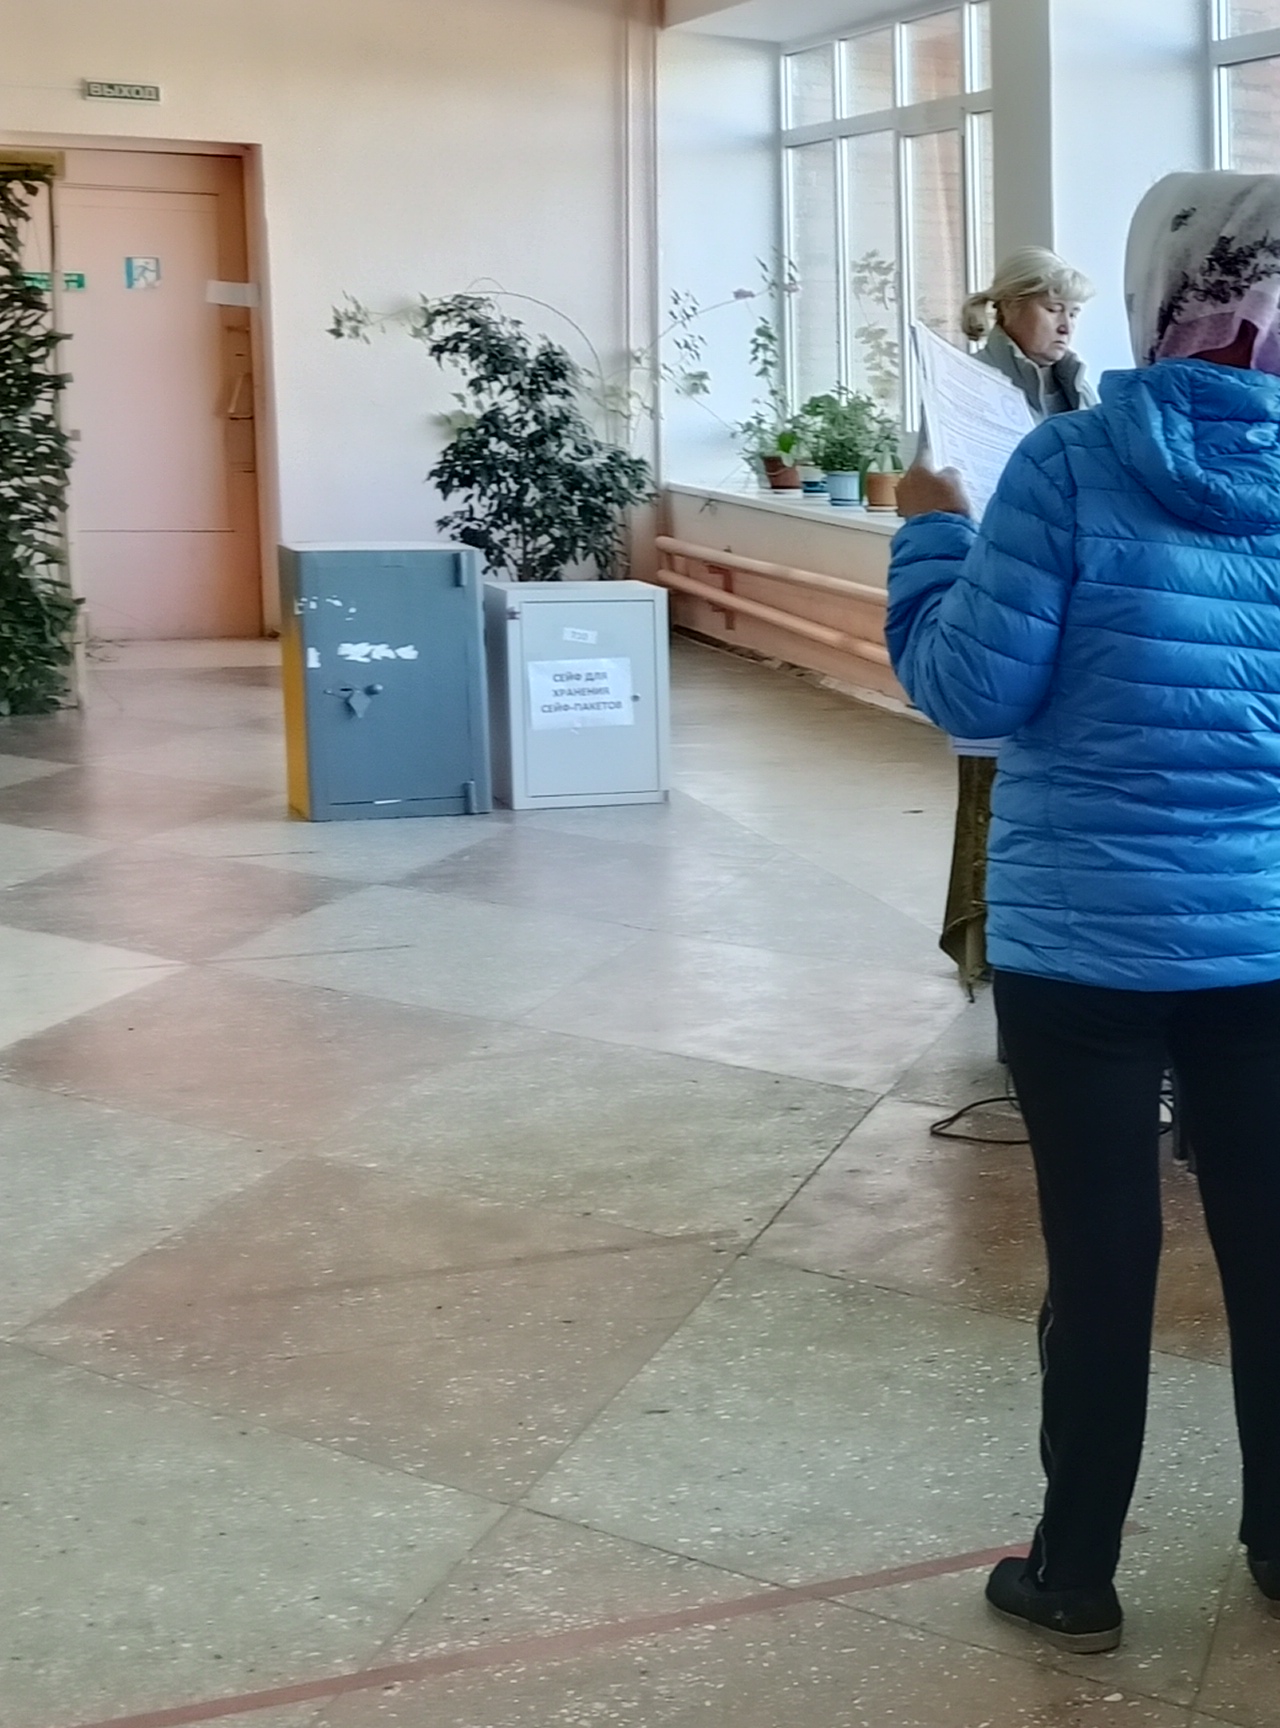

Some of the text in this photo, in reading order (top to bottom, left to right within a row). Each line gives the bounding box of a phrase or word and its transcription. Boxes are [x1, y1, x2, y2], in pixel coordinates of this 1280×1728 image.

[89, 83, 157, 99] ВЫХОД
[552, 671, 608, 682] СЕЙФ ДЛЯ
[552, 686, 610, 698] ХРАНЕНИЯ
[541, 701, 623, 713] СЕЙФ-ПАКЕТОВ
